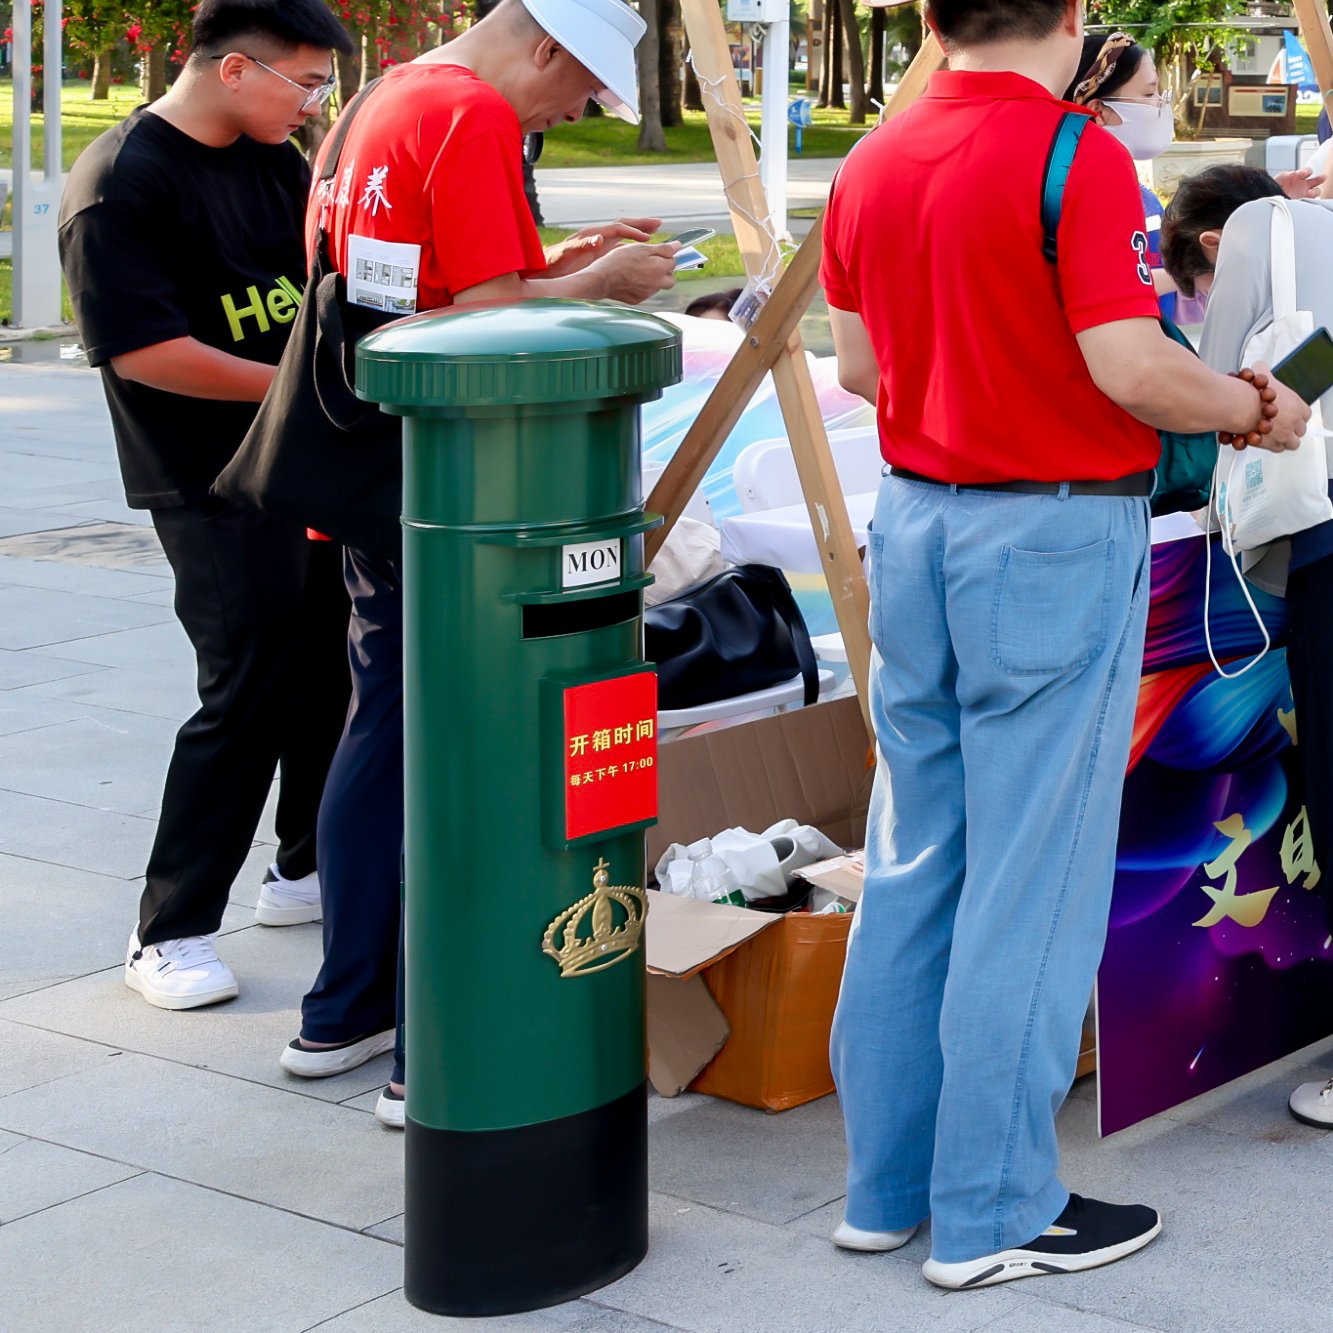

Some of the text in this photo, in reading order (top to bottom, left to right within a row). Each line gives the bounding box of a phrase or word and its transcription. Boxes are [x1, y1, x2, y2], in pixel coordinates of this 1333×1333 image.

[33, 203, 50, 215] 37
[567, 545, 618, 574] MON
[569, 718, 654, 758] 开箱时间
[569, 756, 654, 787] 每天下午 17:00
